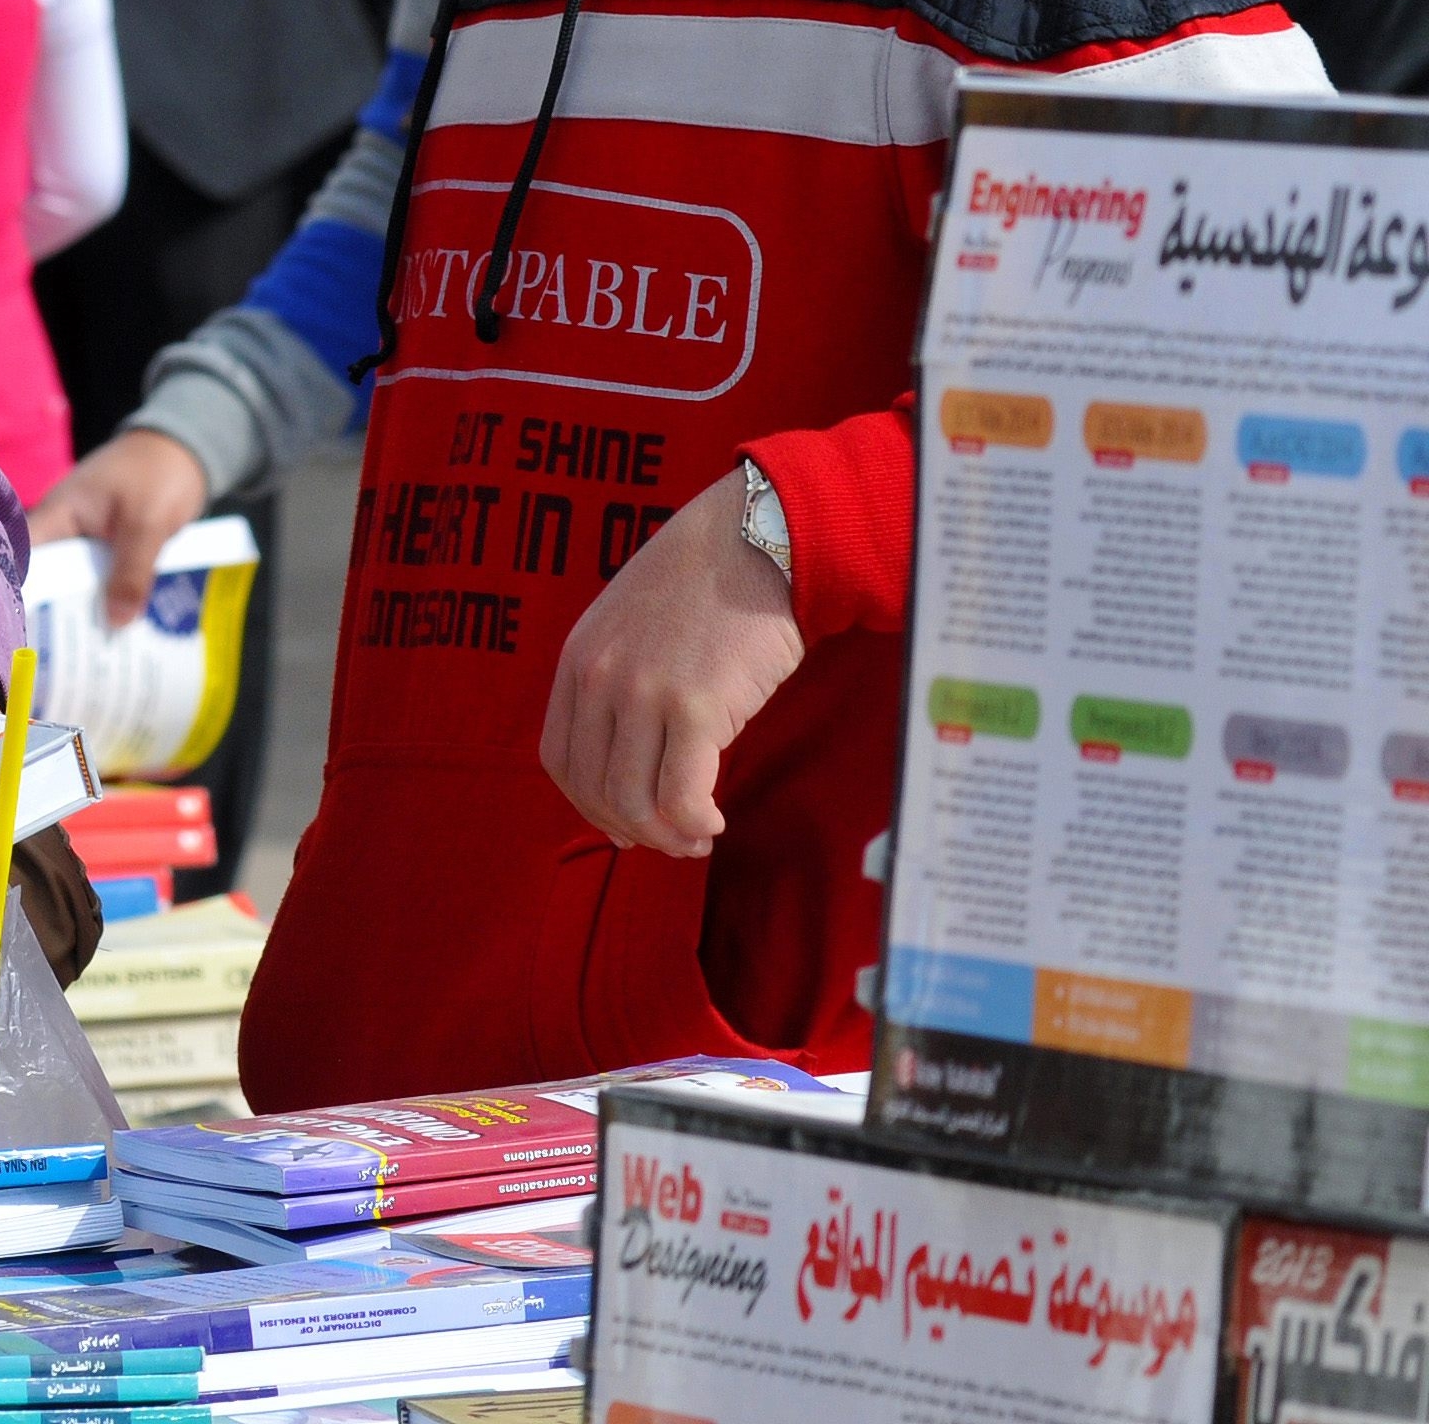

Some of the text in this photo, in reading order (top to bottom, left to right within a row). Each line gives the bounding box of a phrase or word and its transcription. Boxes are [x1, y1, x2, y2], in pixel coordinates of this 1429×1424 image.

[968, 170, 1148, 240] Engineering
[1158, 178, 1348, 306] الهندسية
[388, 245, 729, 344] NSTOPABLE
[514, 415, 667, 487] SHINE
[512, 490, 574, 577] IN
[4, 1159, 27, 1173] SINA
[498, 1175, 587, 1194] Conversations
[503, 1143, 592, 1162] Conversations
[623, 1152, 704, 1225] Web
[618, 1204, 771, 1318] Designing
[796, 1186, 898, 1324] المواقع
[903, 1236, 1038, 1342] تصميم
[1251, 1238, 1336, 1292] 2013
[259, 1307, 417, 1328] COMMON ERRORS IN ENGLISH
[300, 1319, 382, 1335] DICTIONARY OF
[1047, 1228, 1197, 1377] موسوعة
[45, 1383, 101, 1399] دار الطلائع
[50, 1361, 106, 1376] دار الطلائع
